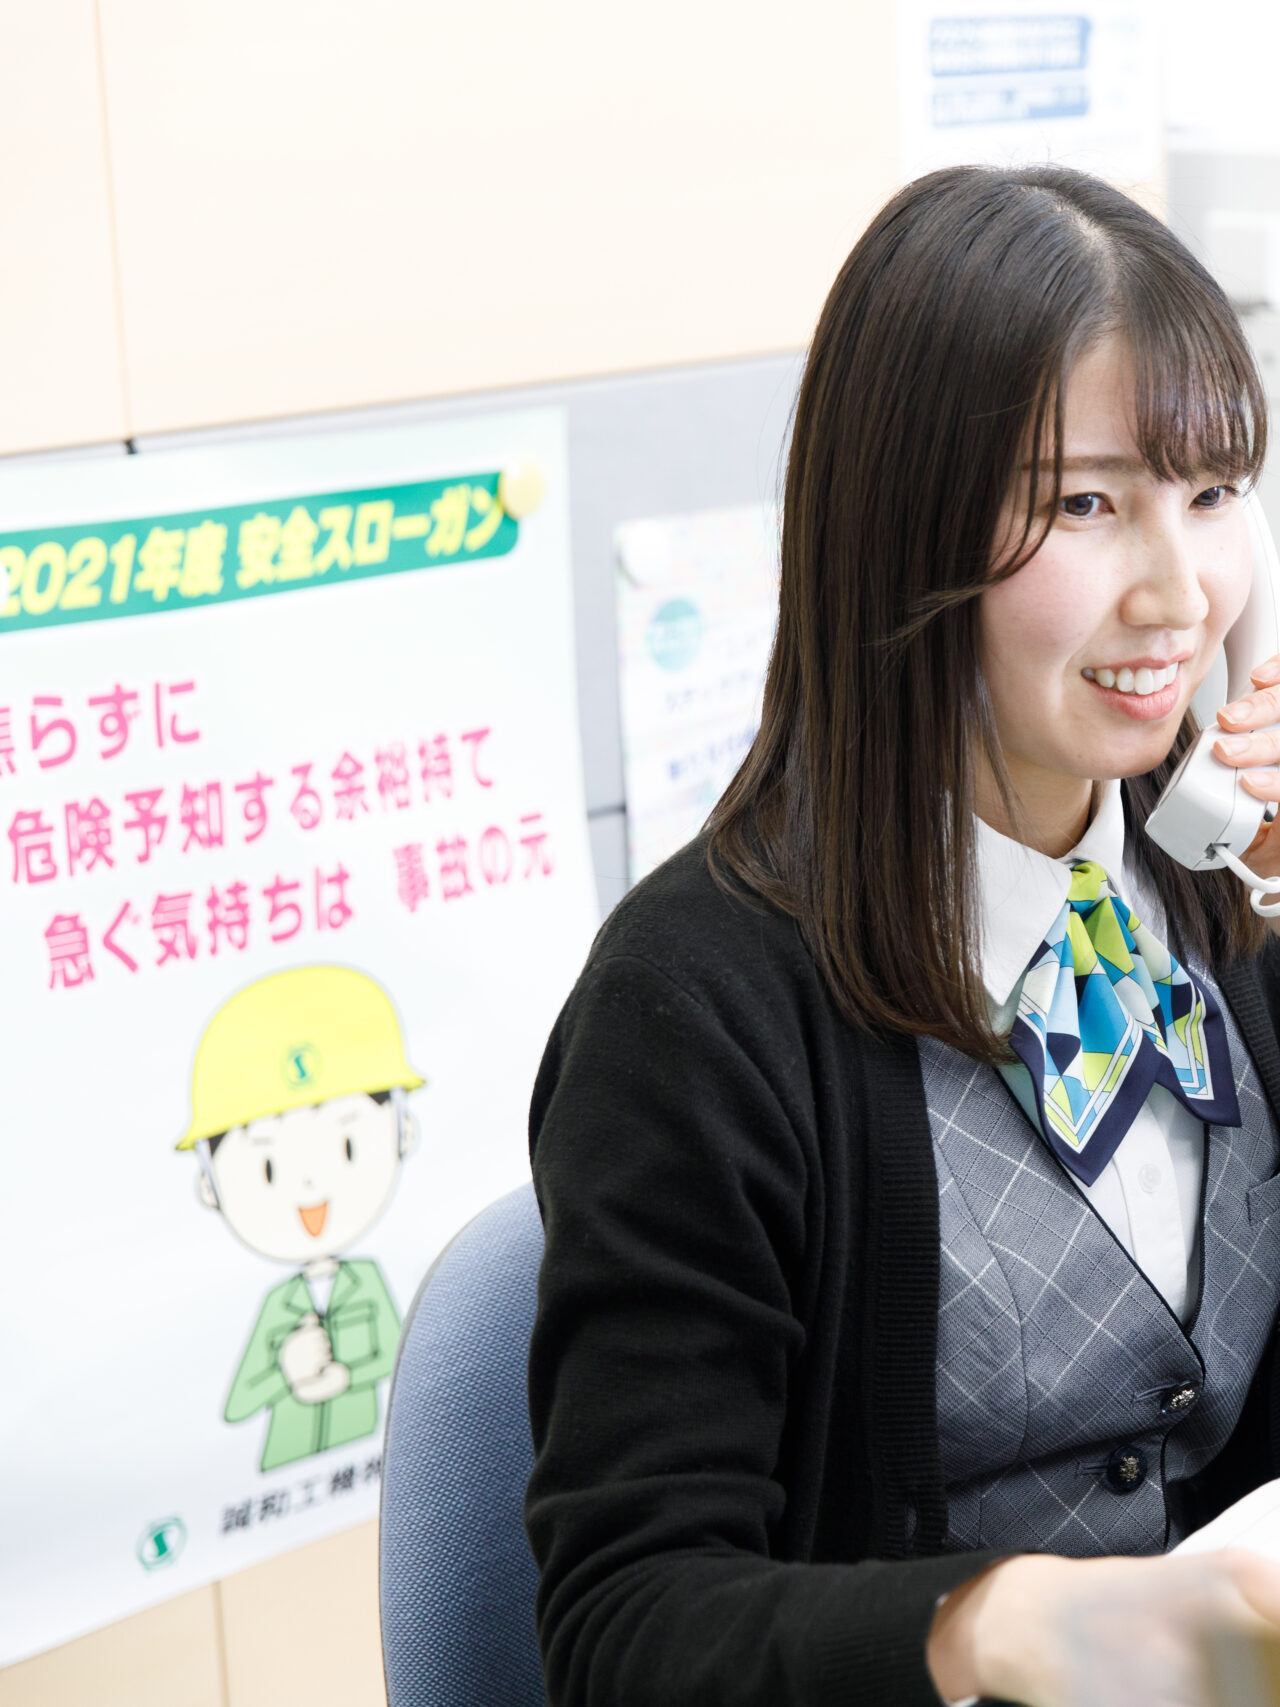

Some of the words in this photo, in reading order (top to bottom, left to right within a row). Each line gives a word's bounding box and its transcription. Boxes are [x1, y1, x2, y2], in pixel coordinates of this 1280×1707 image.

[8, 727, 494, 884] 危険予知する余裕持て
[45, 862, 353, 990] 急ぐ気持ちは
[393, 813, 551, 913] 事故の元
